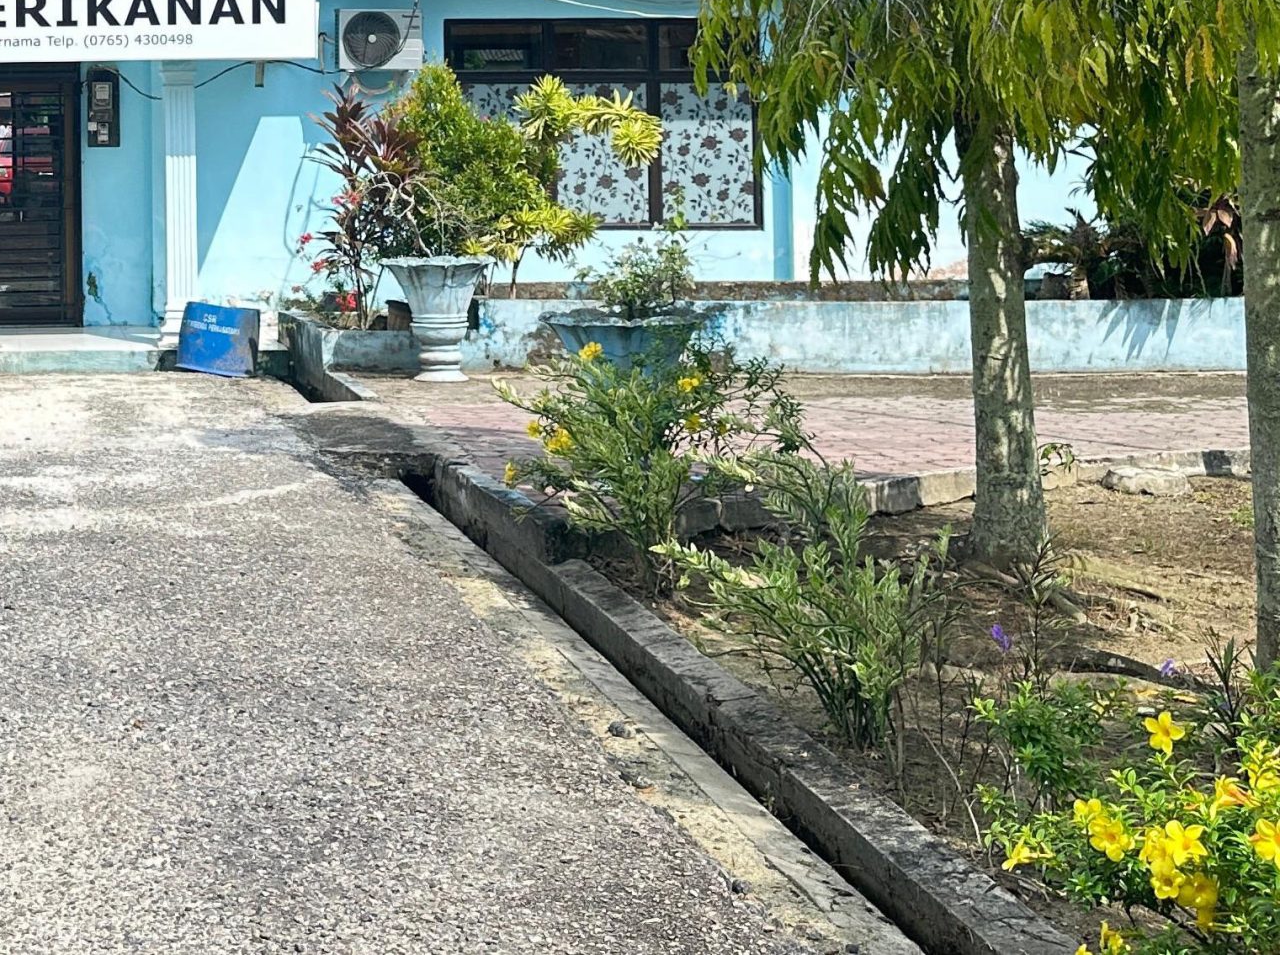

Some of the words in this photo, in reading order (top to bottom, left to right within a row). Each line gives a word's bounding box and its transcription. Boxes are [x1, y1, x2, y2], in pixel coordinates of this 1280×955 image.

[45, 35, 78, 49] Telp.
[83, 34, 129, 48] (0765)
[134, 34, 193, 46] 4300498
